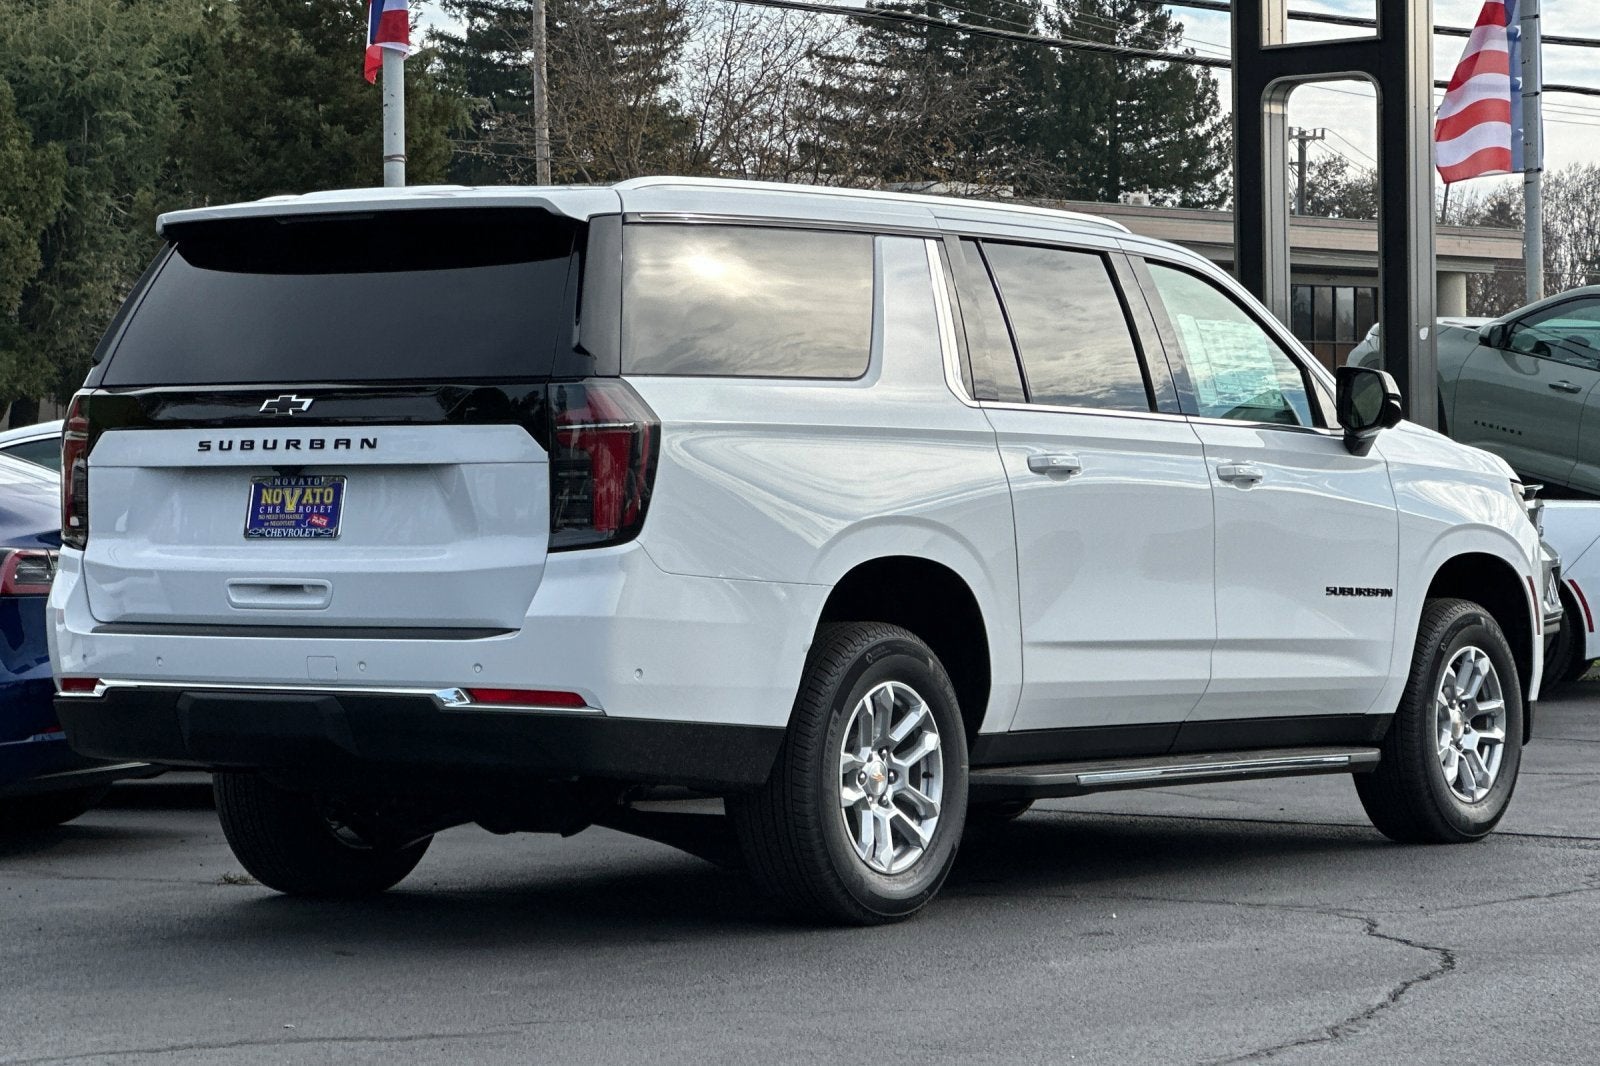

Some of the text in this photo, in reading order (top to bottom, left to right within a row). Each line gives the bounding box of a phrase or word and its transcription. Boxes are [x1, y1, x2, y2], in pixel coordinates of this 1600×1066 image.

[197, 438, 378, 452] SUBURBAN
[274, 477, 320, 486] NOVATO
[261, 487, 334, 513] NOVATO
[265, 527, 316, 538] CHEVROLET
[1325, 586, 1393, 598] SUBURBAN
